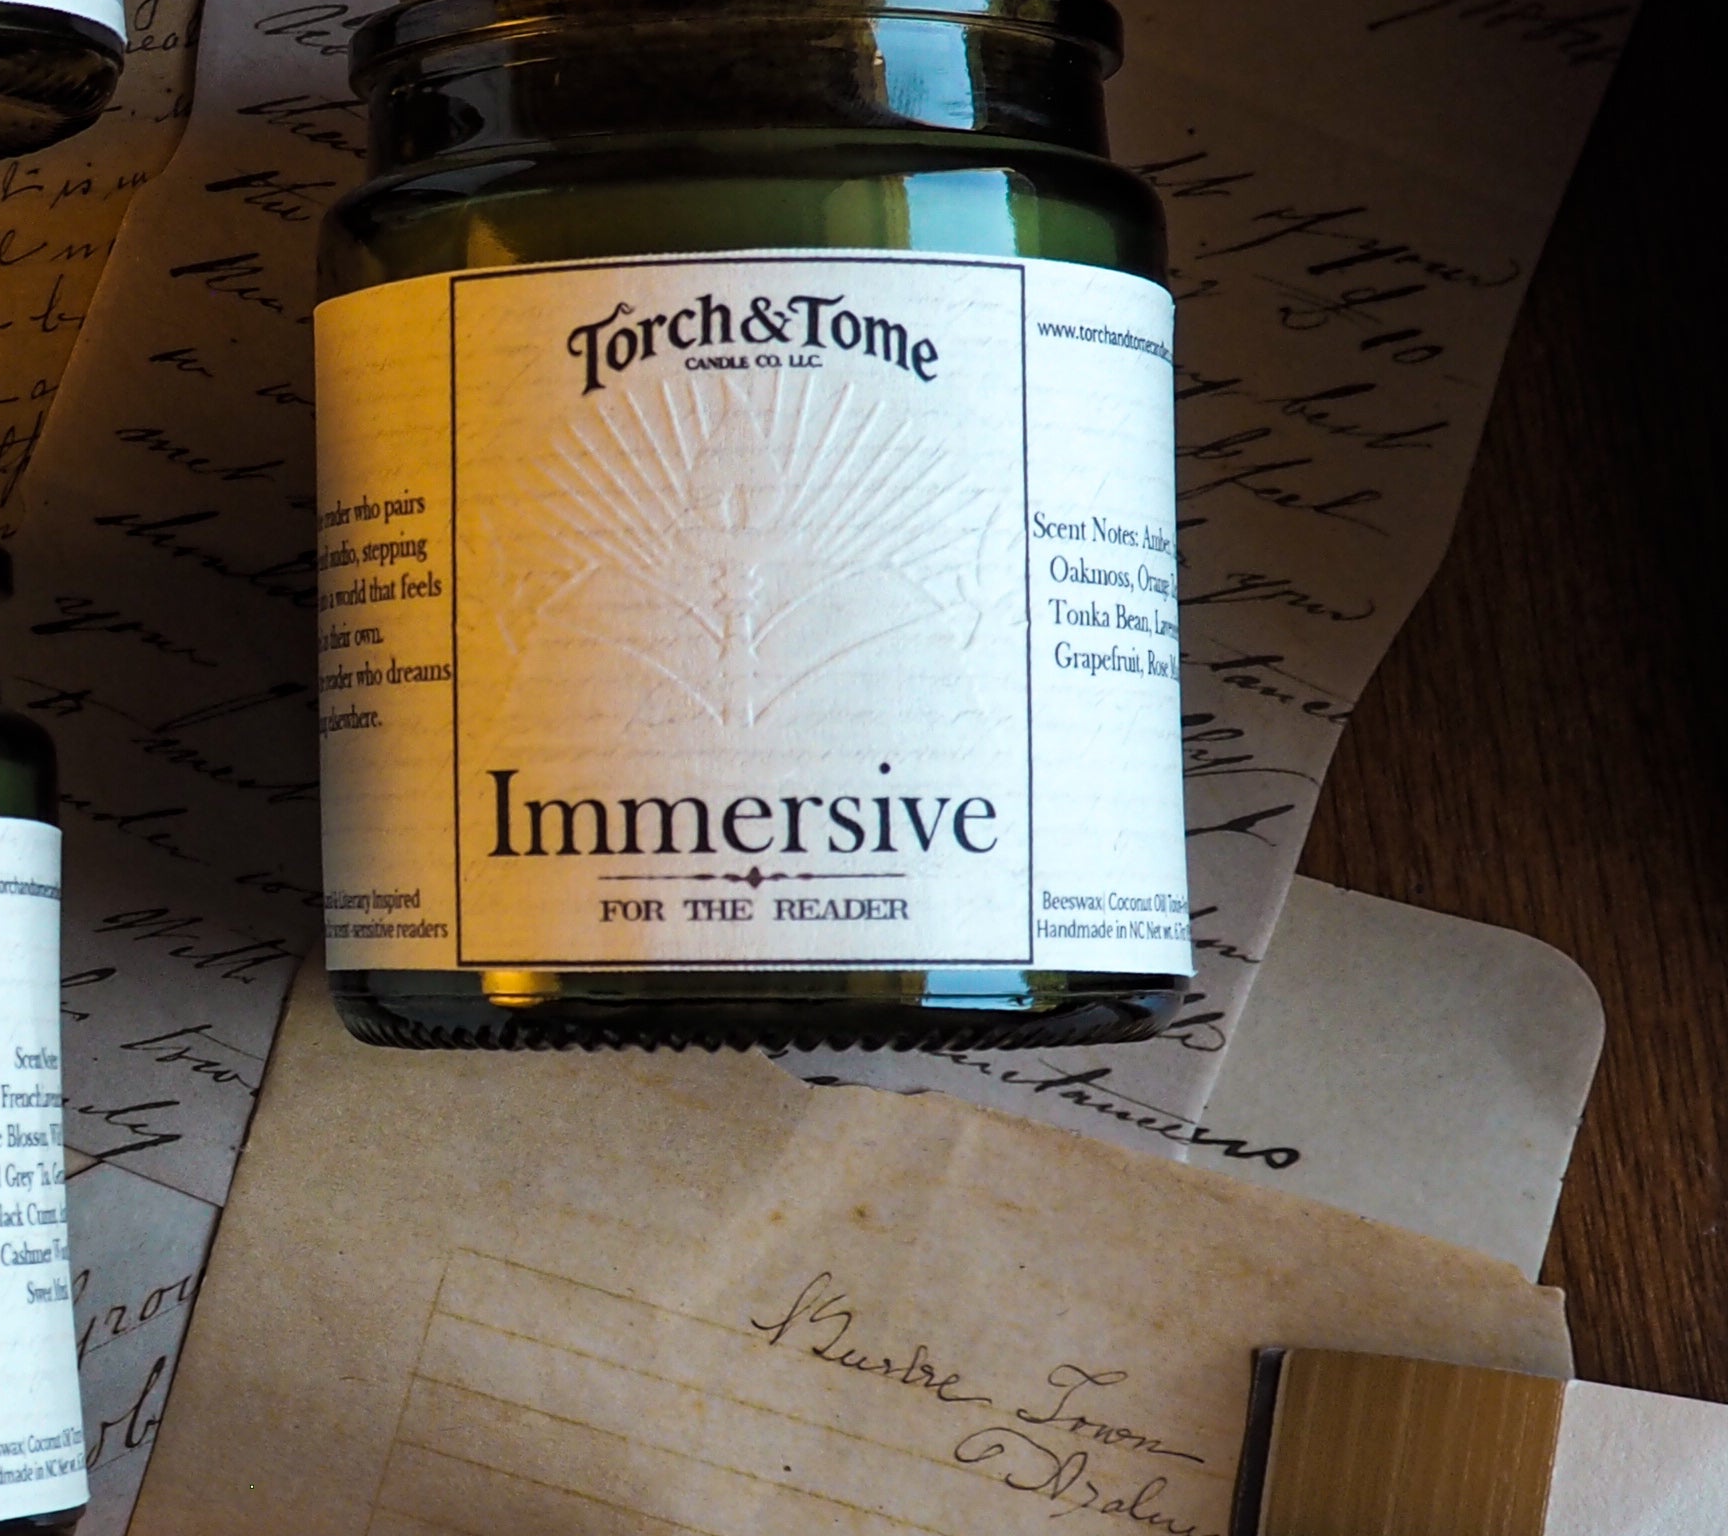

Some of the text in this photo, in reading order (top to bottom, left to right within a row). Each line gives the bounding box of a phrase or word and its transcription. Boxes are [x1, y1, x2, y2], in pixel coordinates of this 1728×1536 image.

[685, 356, 749, 371] CANDLE
[755, 354, 783, 369] CO.
[354, 488, 425, 524] who pairs
[1033, 510, 1140, 548] Scent Notes:
[362, 530, 427, 567] stepping
[335, 570, 443, 605] world that feels
[1049, 555, 1135, 594] Oakmoss,
[1048, 597, 1153, 638] Tonka Bean,
[354, 627, 384, 646] own.
[356, 657, 452, 686] who dreams
[1055, 640, 1145, 680] Grapefruit,
[1148, 648, 1170, 678] Rose
[486, 761, 998, 858] Immersive
[599, 897, 909, 922] FOR THE READER
[1108, 891, 1153, 913] Coconut
[396, 918, 449, 939] readers
[1037, 918, 1114, 940] Handmade
[1116, 918, 1128, 940] in
[1129, 920, 1146, 941] NC
[5, 1162, 35, 1192] Grey
